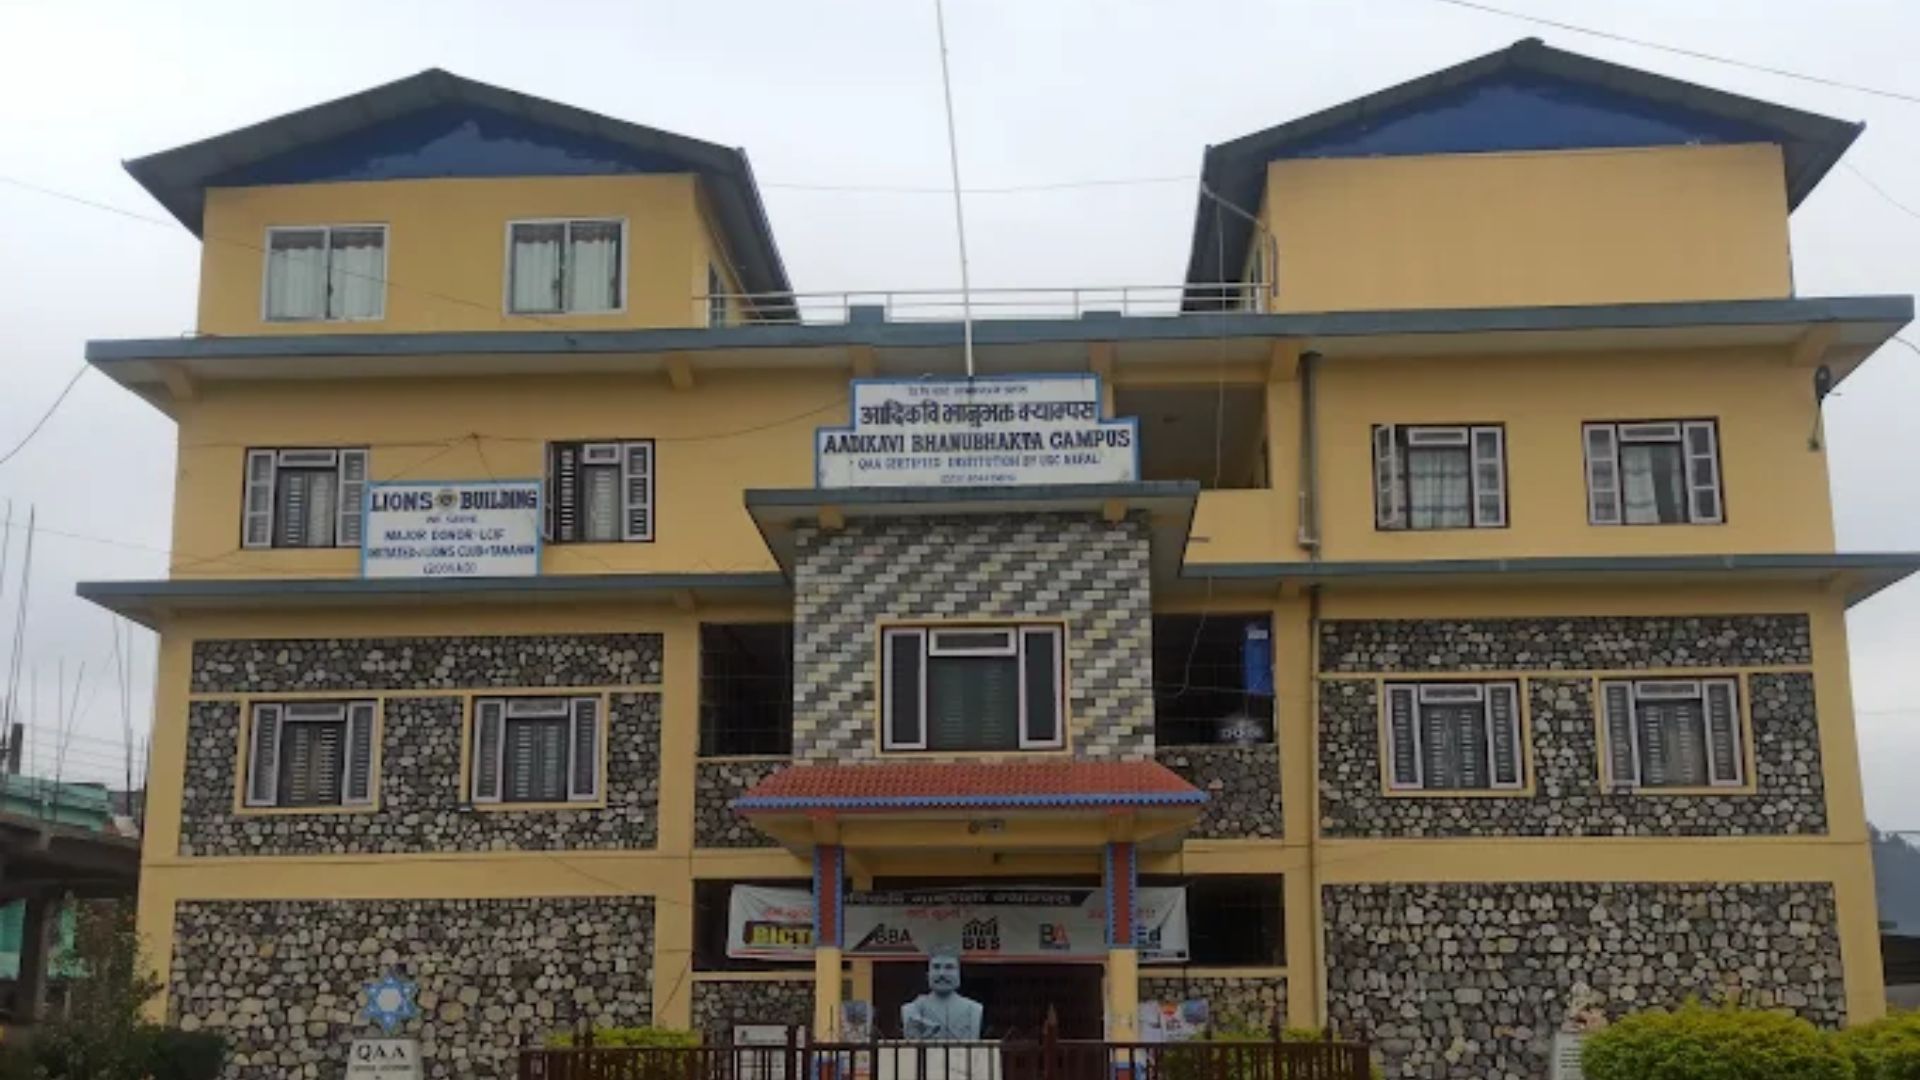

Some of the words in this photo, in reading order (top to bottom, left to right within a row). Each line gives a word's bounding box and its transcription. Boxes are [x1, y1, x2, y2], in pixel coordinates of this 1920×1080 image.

[824, 433, 905, 454] AADIKAVI
[911, 431, 1044, 453] BHANUBHAKTA
[1049, 429, 1131, 450] CAMPUS
[371, 491, 433, 512] LIONS
[460, 489, 537, 510] BUILDING
[874, 927, 912, 944] BBA
[357, 1045, 405, 1063] QAA
